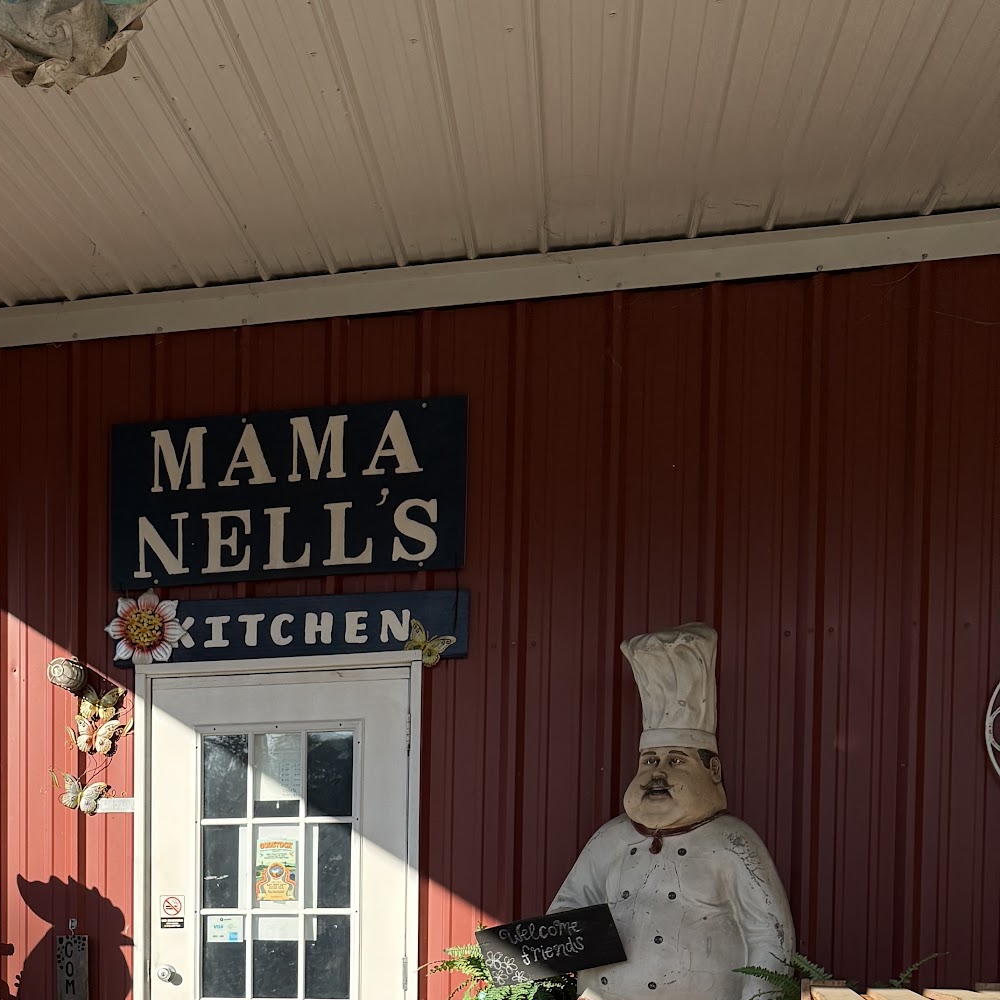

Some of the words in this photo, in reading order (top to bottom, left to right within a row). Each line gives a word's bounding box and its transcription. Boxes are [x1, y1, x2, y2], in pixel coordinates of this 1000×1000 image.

[150, 410, 424, 493] MAMA
[133, 487, 438, 579] NELL'S
[173, 608, 412, 649] KITCHEN
[498, 919, 582, 945] Welcome
[521, 936, 585, 966] friends
